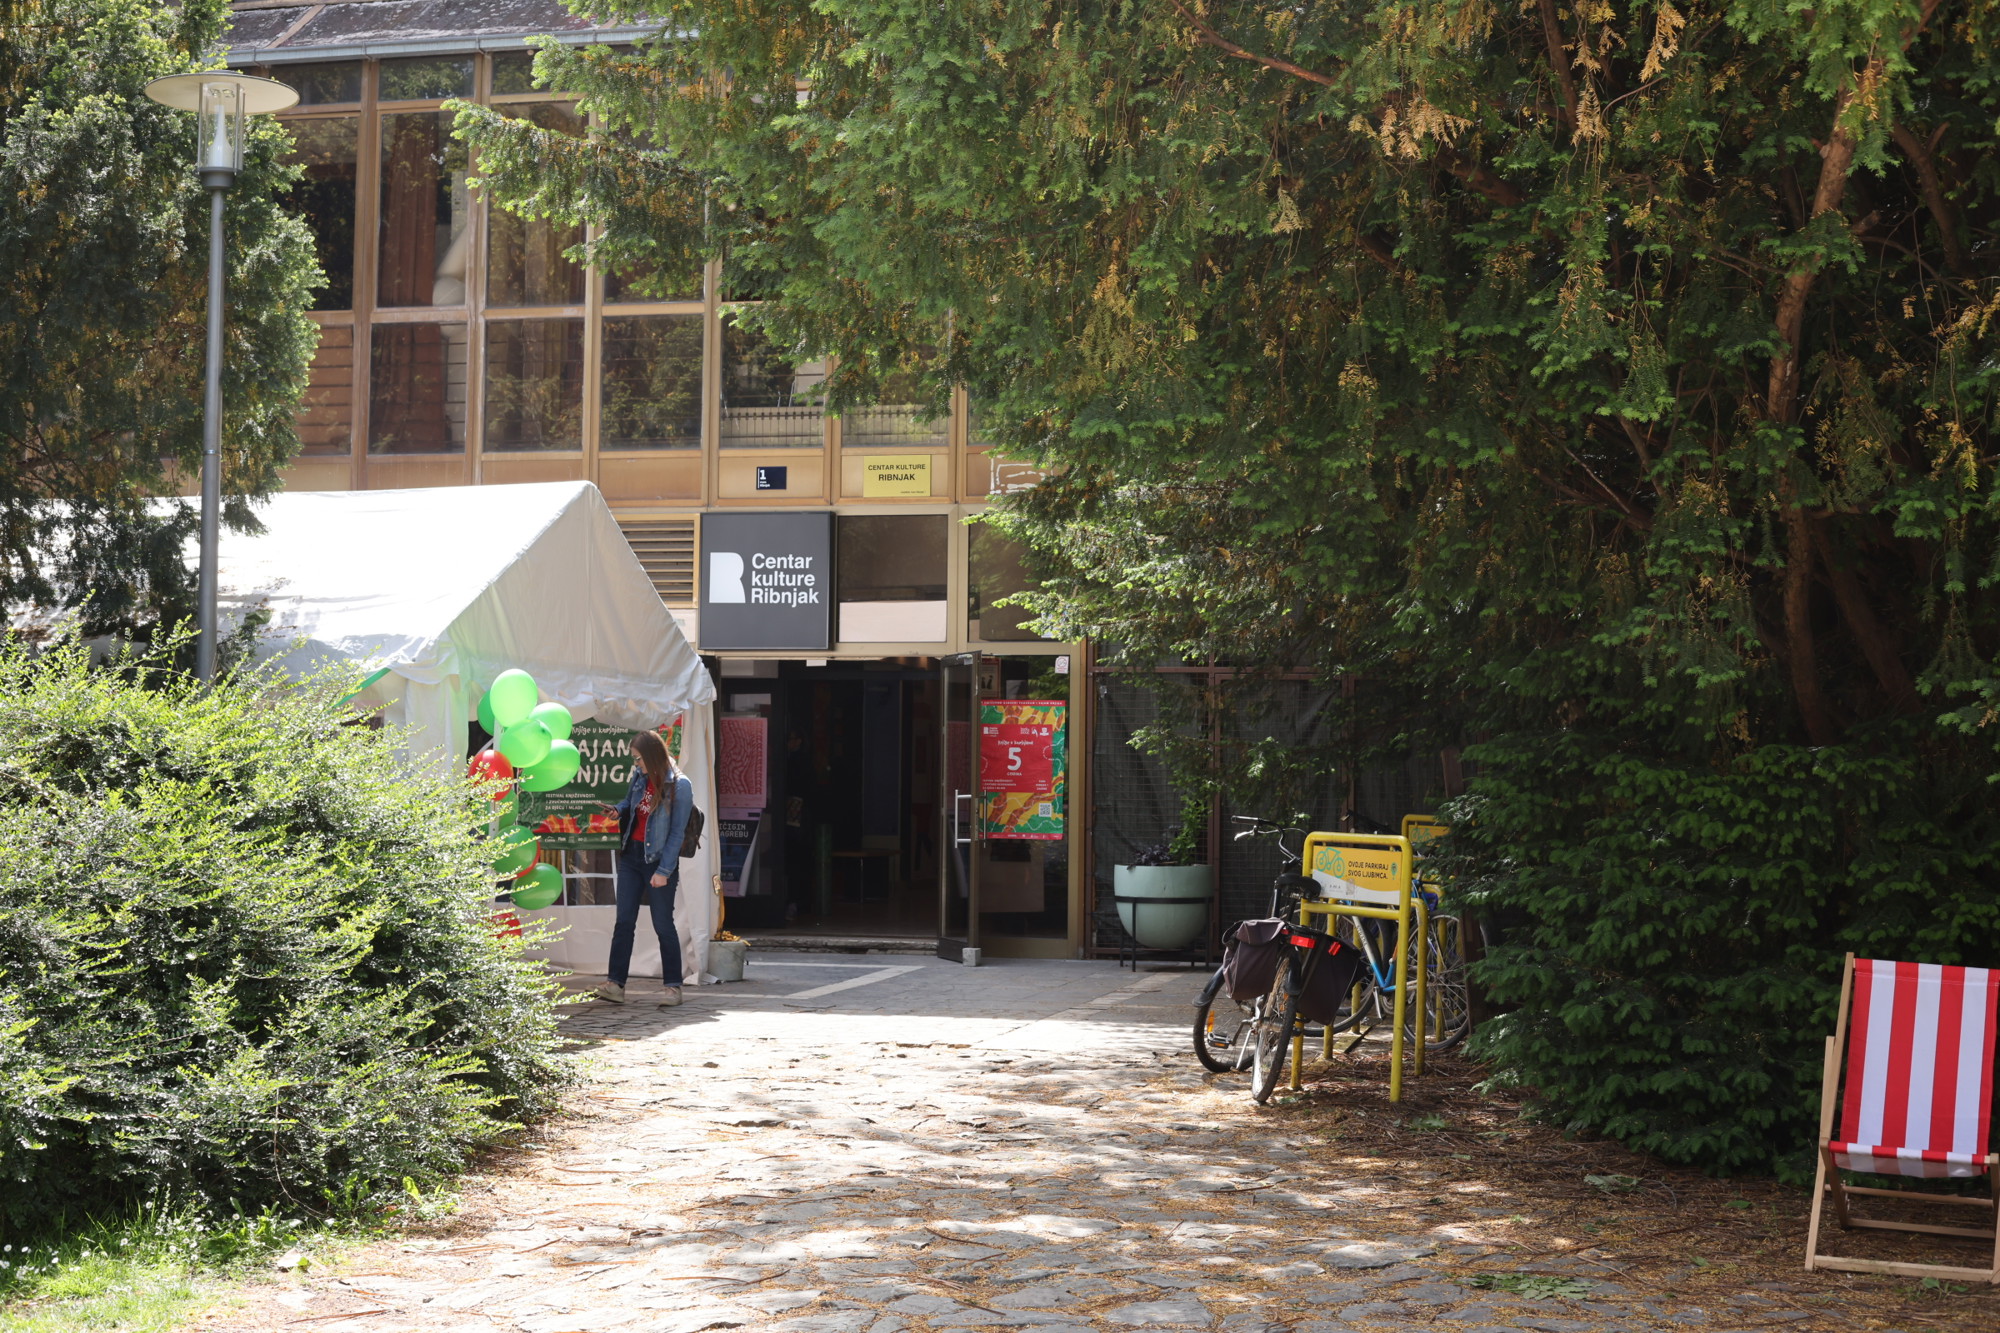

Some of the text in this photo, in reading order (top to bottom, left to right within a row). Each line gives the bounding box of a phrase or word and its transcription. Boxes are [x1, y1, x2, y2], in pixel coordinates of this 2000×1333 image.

[760, 470, 766, 480] 1
[879, 473, 915, 481] RIBNJAK
[751, 553, 813, 569] Centar
[751, 571, 815, 586] kulture
[751, 588, 819, 608] Ribnjak
[572, 726, 591, 735] Knjige
[570, 738, 632, 762] AJAM
[1007, 747, 1022, 771] 5
[571, 764, 637, 788] NJIGA
[719, 821, 746, 830] IČIGIN
[720, 830, 749, 838] AGREBU
[1365, 862, 1388, 870] PARKIRAJ
